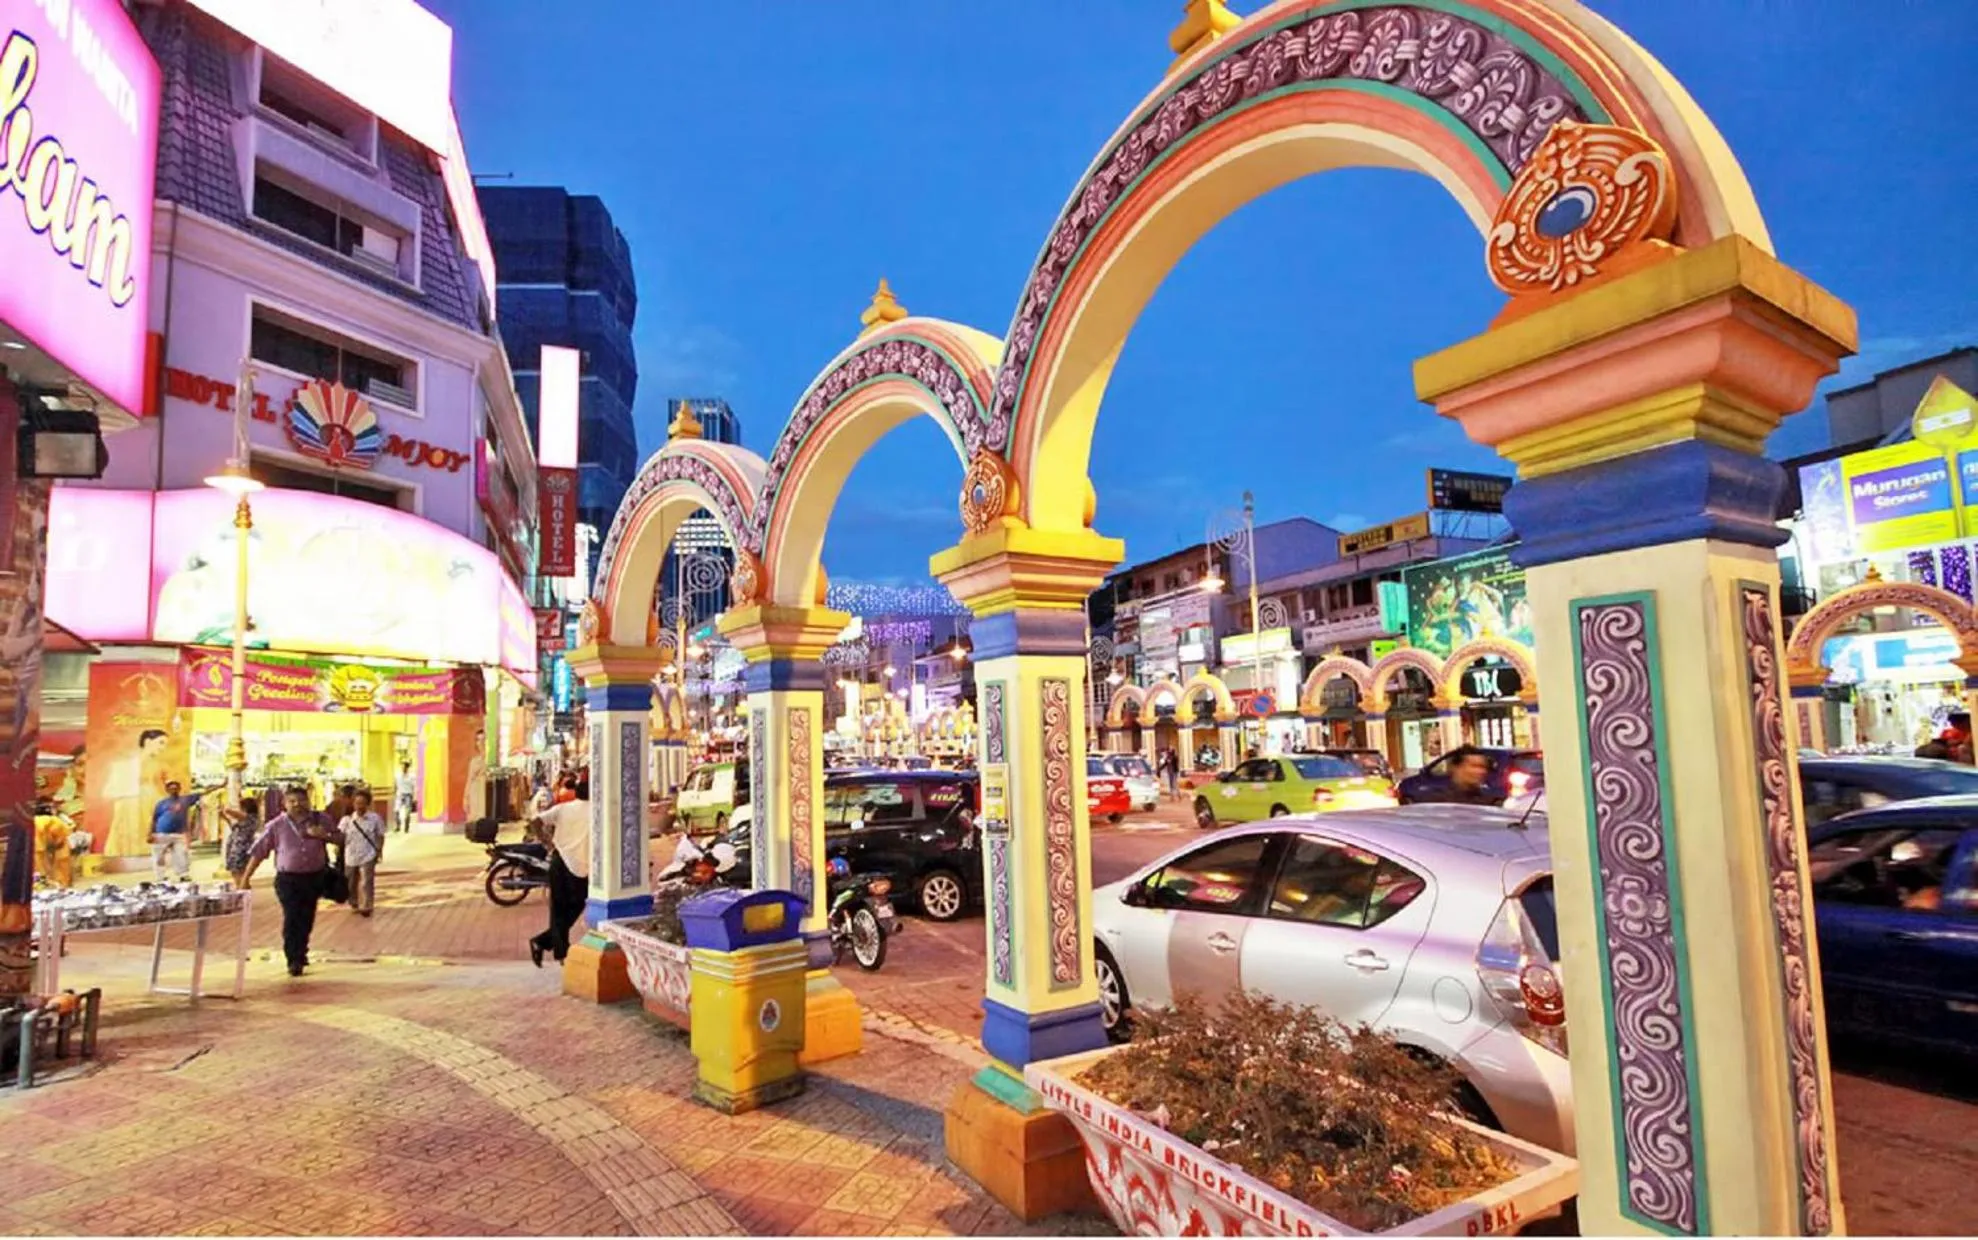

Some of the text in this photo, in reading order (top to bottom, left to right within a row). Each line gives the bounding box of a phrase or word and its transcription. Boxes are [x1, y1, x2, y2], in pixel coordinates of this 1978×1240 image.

[162, 367, 277, 424] HOTL
[1853, 469, 1947, 498] Murugan
[553, 495, 564, 563] HOTEL
[1041, 1079, 1093, 1121] LITTLE
[1100, 1111, 1152, 1154] INDIA
[1467, 1201, 1520, 1237] DBKL
